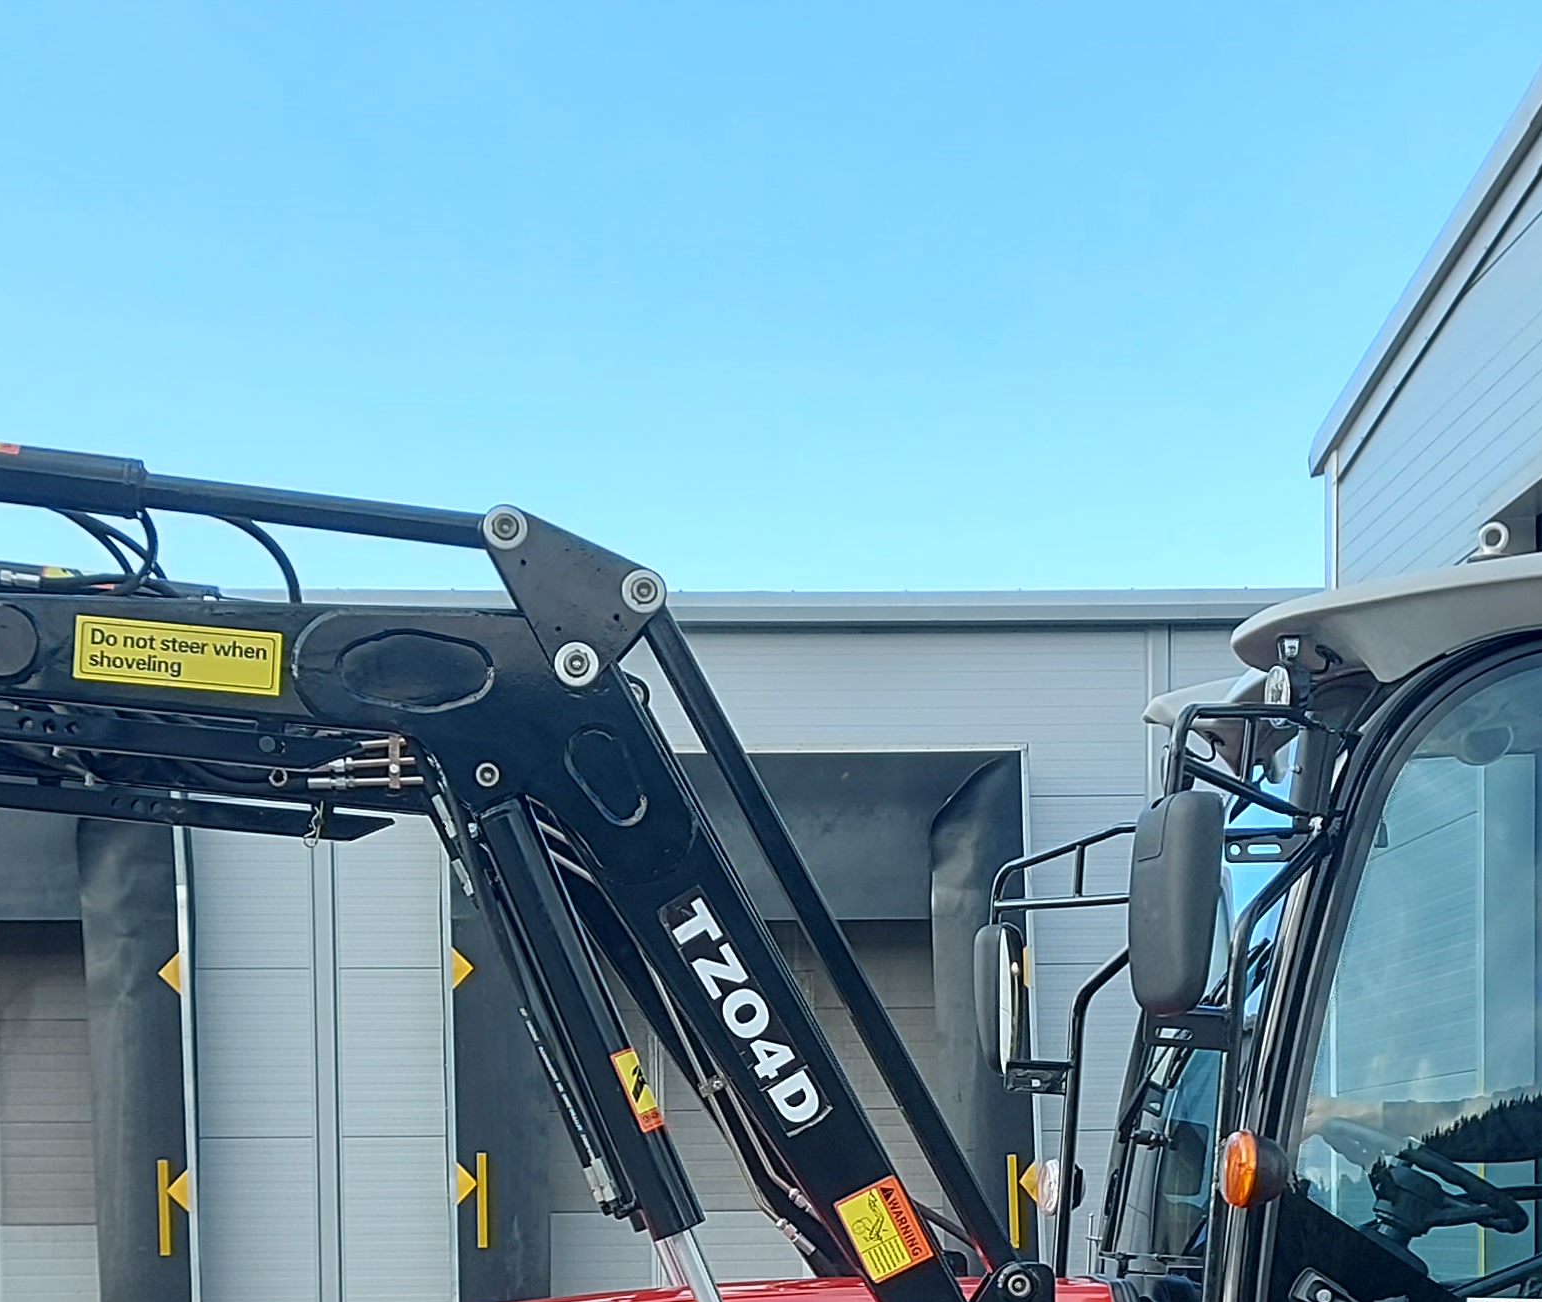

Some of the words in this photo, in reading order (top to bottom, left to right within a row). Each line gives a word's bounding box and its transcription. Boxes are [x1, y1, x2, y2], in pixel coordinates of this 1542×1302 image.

[90, 628, 117, 647] Do
[122, 634, 156, 651] not
[161, 637, 208, 655] steer
[213, 641, 267, 660] when
[88, 651, 182, 677] shoveling
[890, 1197, 923, 1257] WARNING
